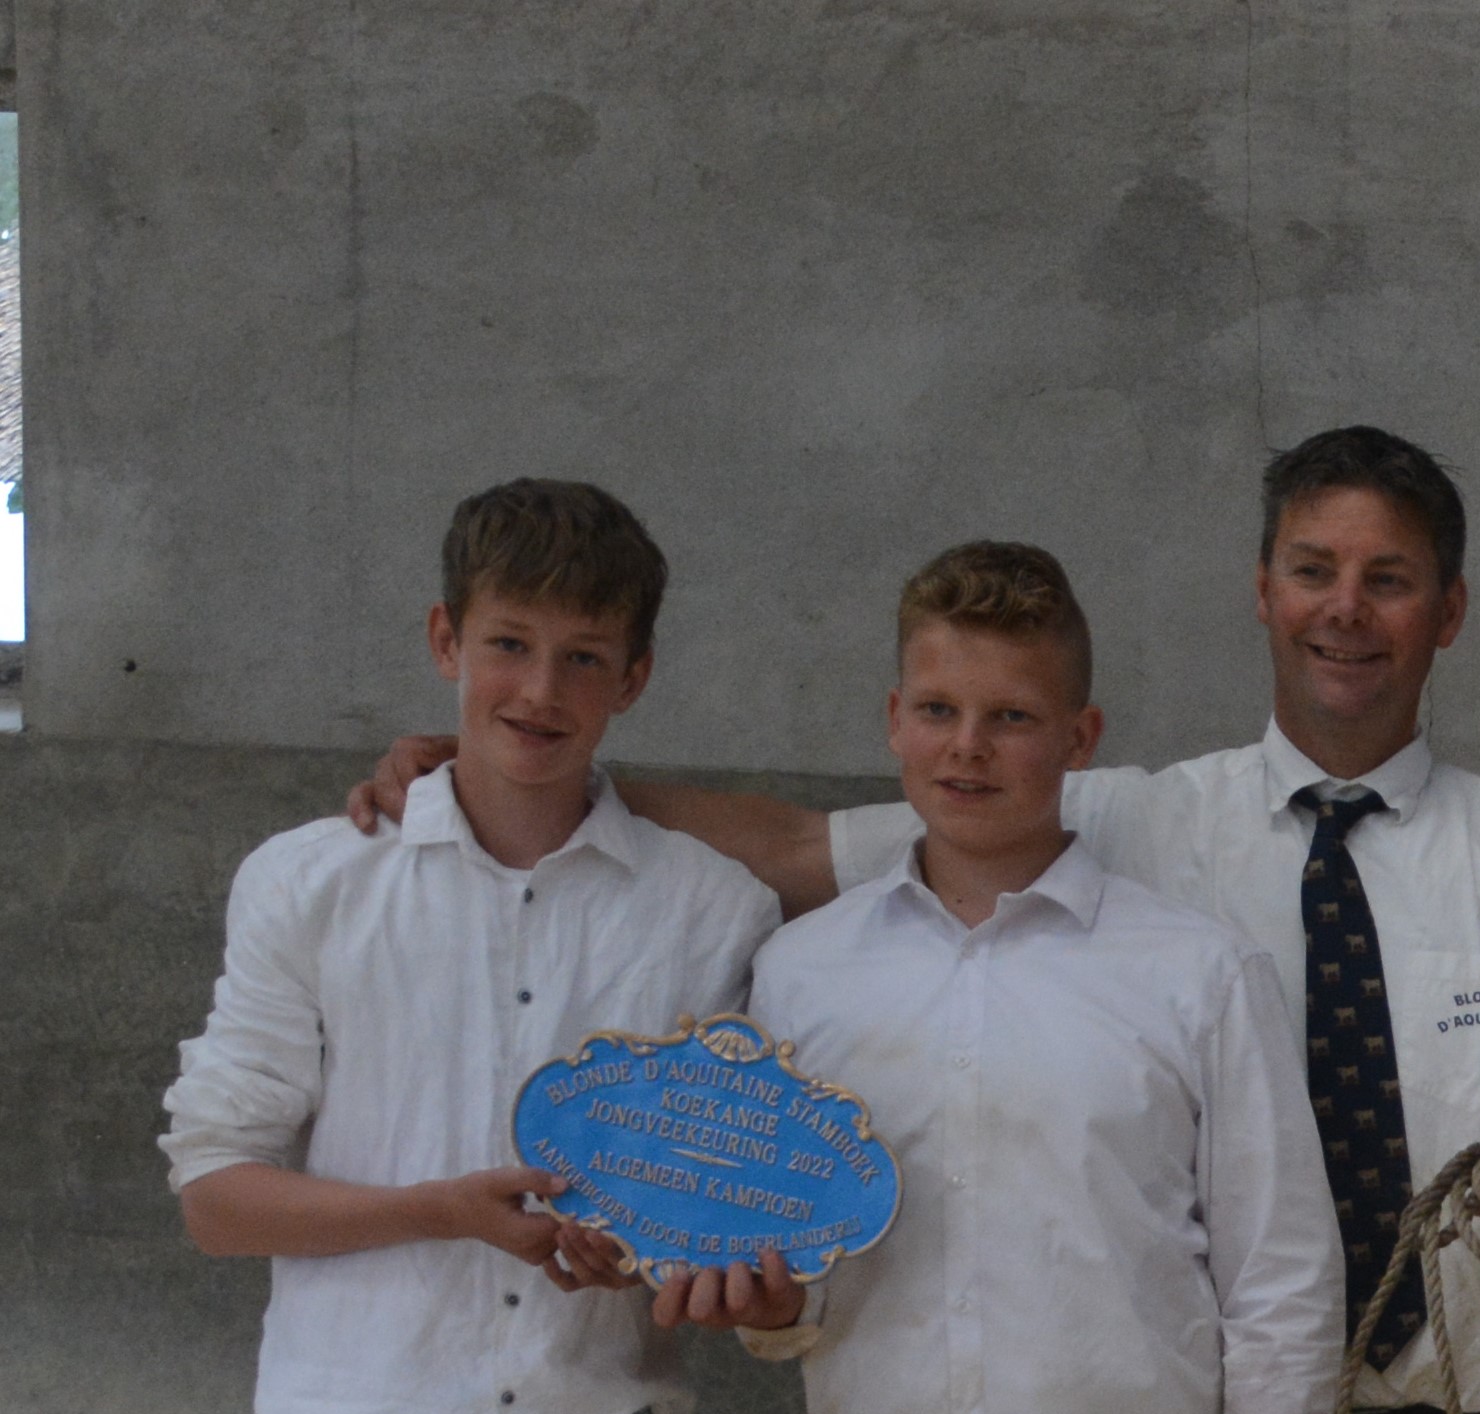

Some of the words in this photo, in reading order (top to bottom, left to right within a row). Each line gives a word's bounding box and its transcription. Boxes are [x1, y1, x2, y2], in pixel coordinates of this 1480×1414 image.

[546, 1060, 635, 1107] BLONDE
[786, 1098, 881, 1187] STAMBOEK
[585, 1098, 779, 1165] JONGVEEKEURING
[786, 1149, 836, 1180] 2022
[660, 1087, 780, 1137] KOEKANGE
[532, 1136, 638, 1228] AANGEBODEN
[637, 1216, 690, 1249] DOOR
[698, 1230, 721, 1253] DE
[587, 1149, 701, 1194] ALGEMEEN
[704, 1178, 815, 1222] KAMPIOEN
